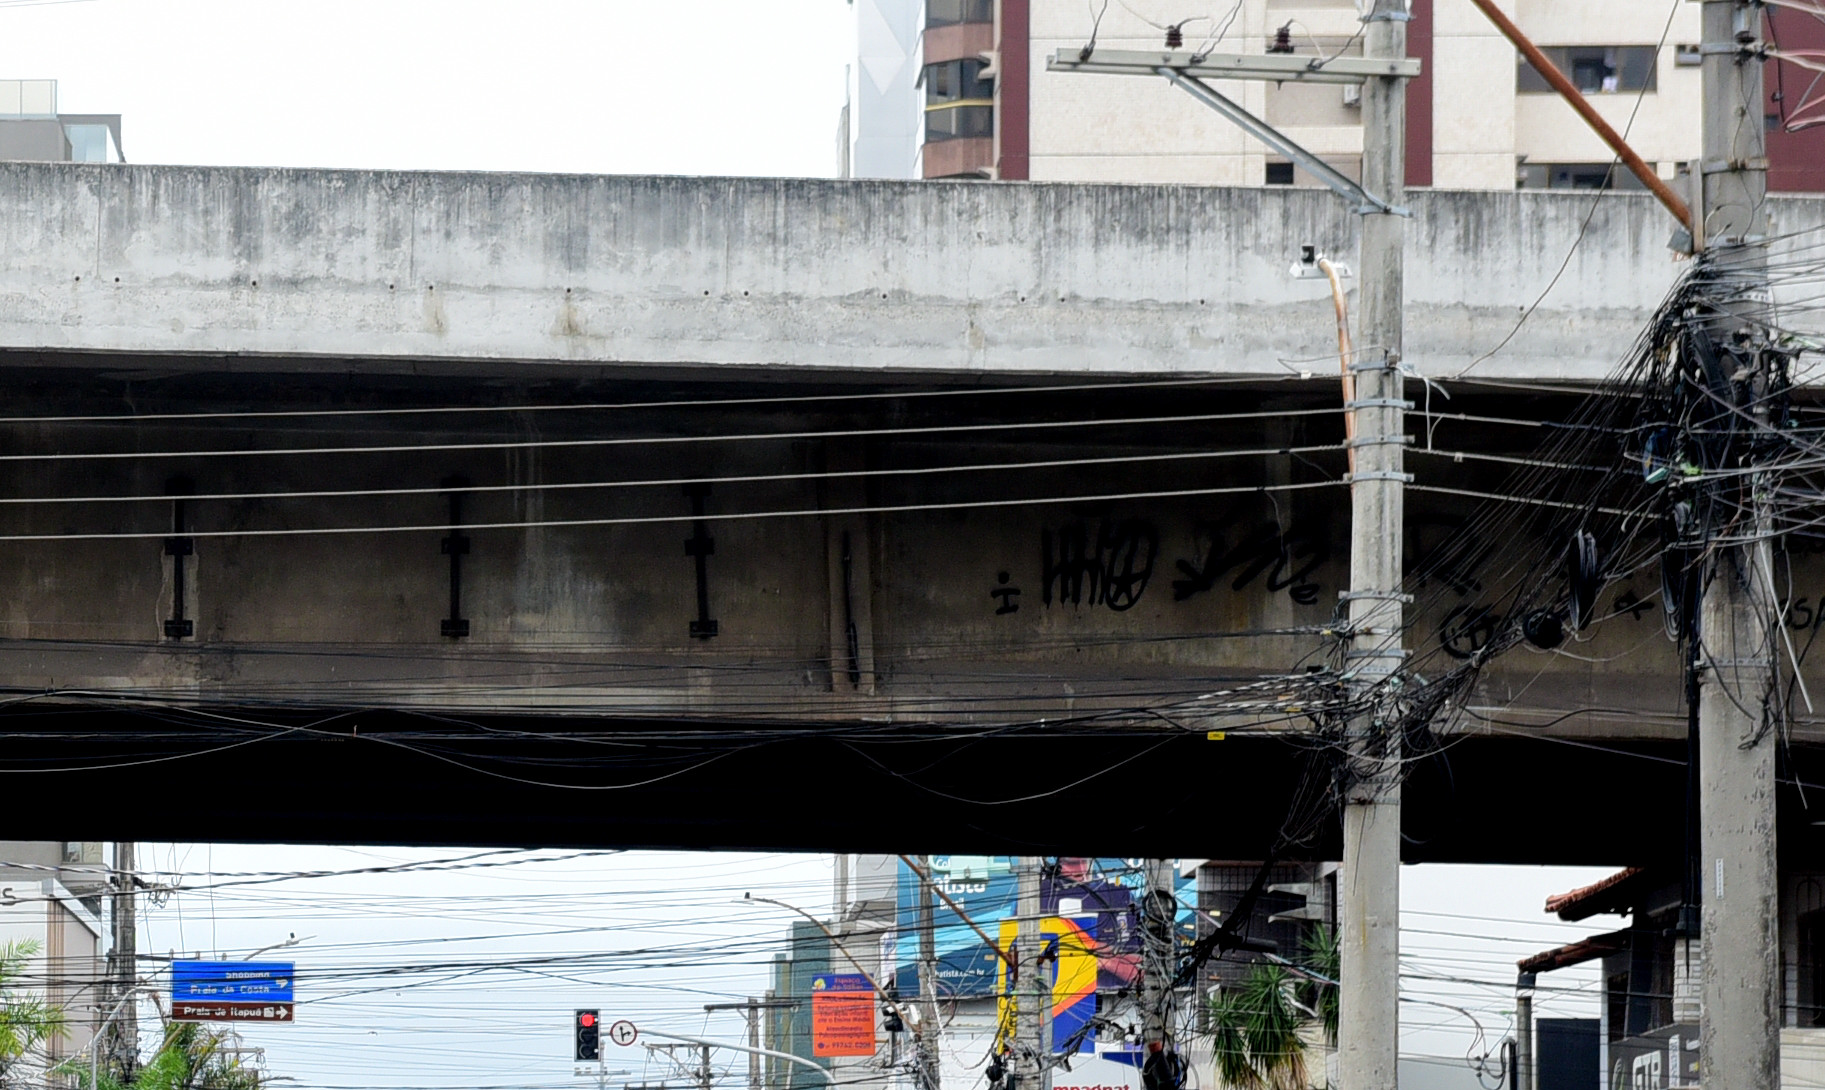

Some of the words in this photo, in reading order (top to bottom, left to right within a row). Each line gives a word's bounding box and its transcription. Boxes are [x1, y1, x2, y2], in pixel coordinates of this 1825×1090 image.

[931, 875, 986, 894] atista
[184, 1006, 211, 1016] Praia
[215, 1007, 227, 1016] de
